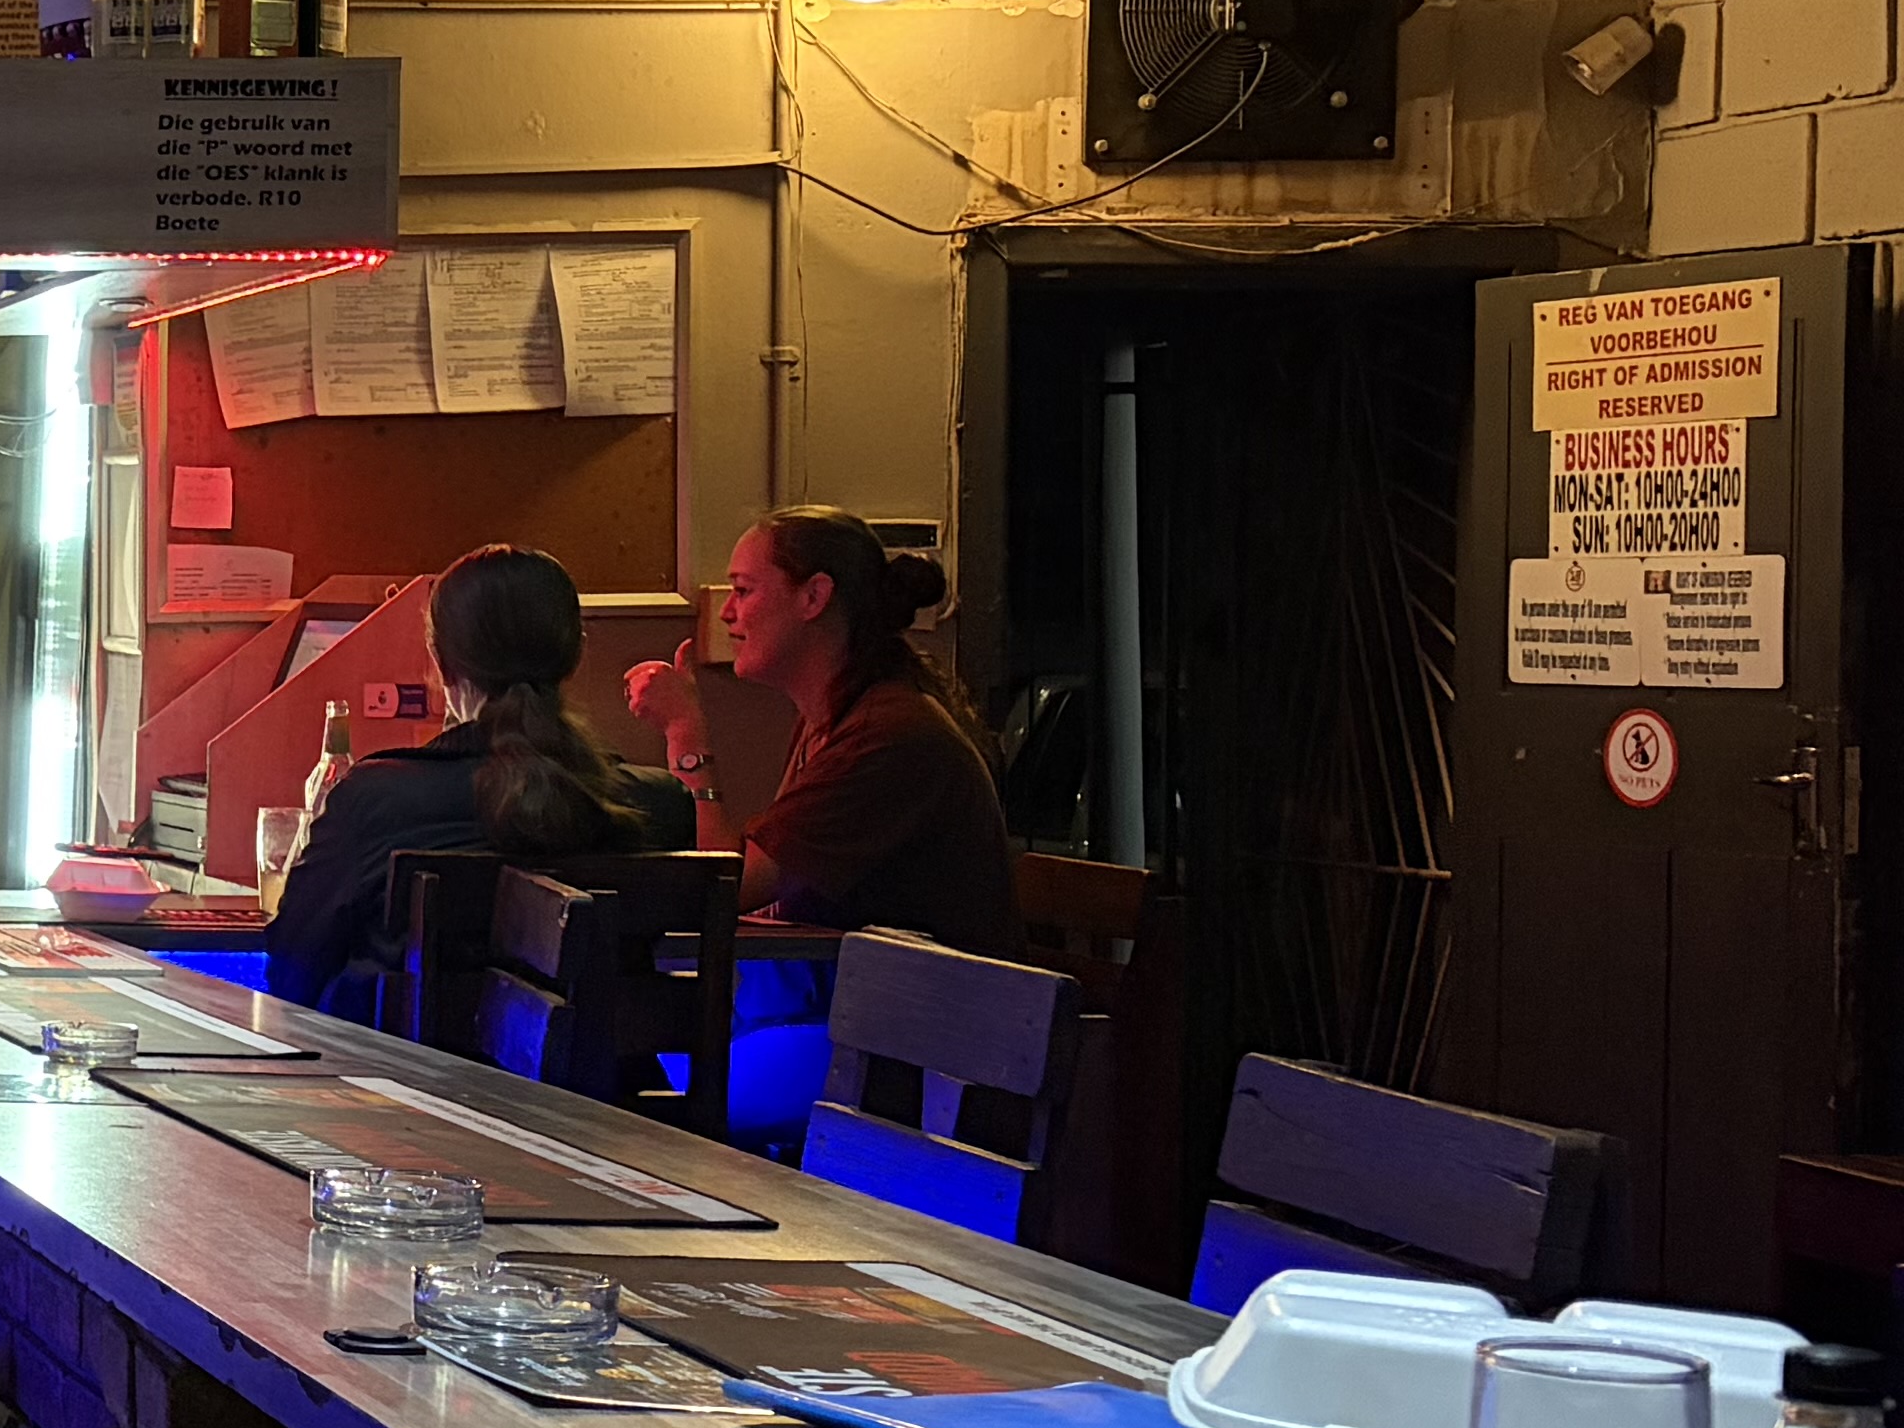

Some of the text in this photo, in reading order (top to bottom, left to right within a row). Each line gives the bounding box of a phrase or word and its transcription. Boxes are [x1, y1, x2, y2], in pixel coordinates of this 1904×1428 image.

[164, 79, 326, 97] KENNISGEWING
[158, 114, 330, 134] Die gebruik van
[157, 140, 192, 156] die
[233, 140, 305, 156] woord
[310, 141, 353, 156] met
[156, 165, 192, 181] die
[263, 165, 325, 181] klank
[330, 165, 348, 181] is
[155, 190, 302, 206] verbode. R10
[155, 215, 221, 231] Boete
[1558, 288, 1754, 327] REG VAN TOEGANG
[1589, 324, 1719, 355] VOORBEHOU
[1546, 355, 1764, 392] RIGHT OF ADMISSION
[1597, 392, 1705, 420] RESERVED
[1563, 423, 1731, 473] BUSINESS HOURS
[1553, 466, 1742, 514] MON-SAT: 10H00-24H00
[1571, 511, 1721, 555] SUN: 10H00-20H00
